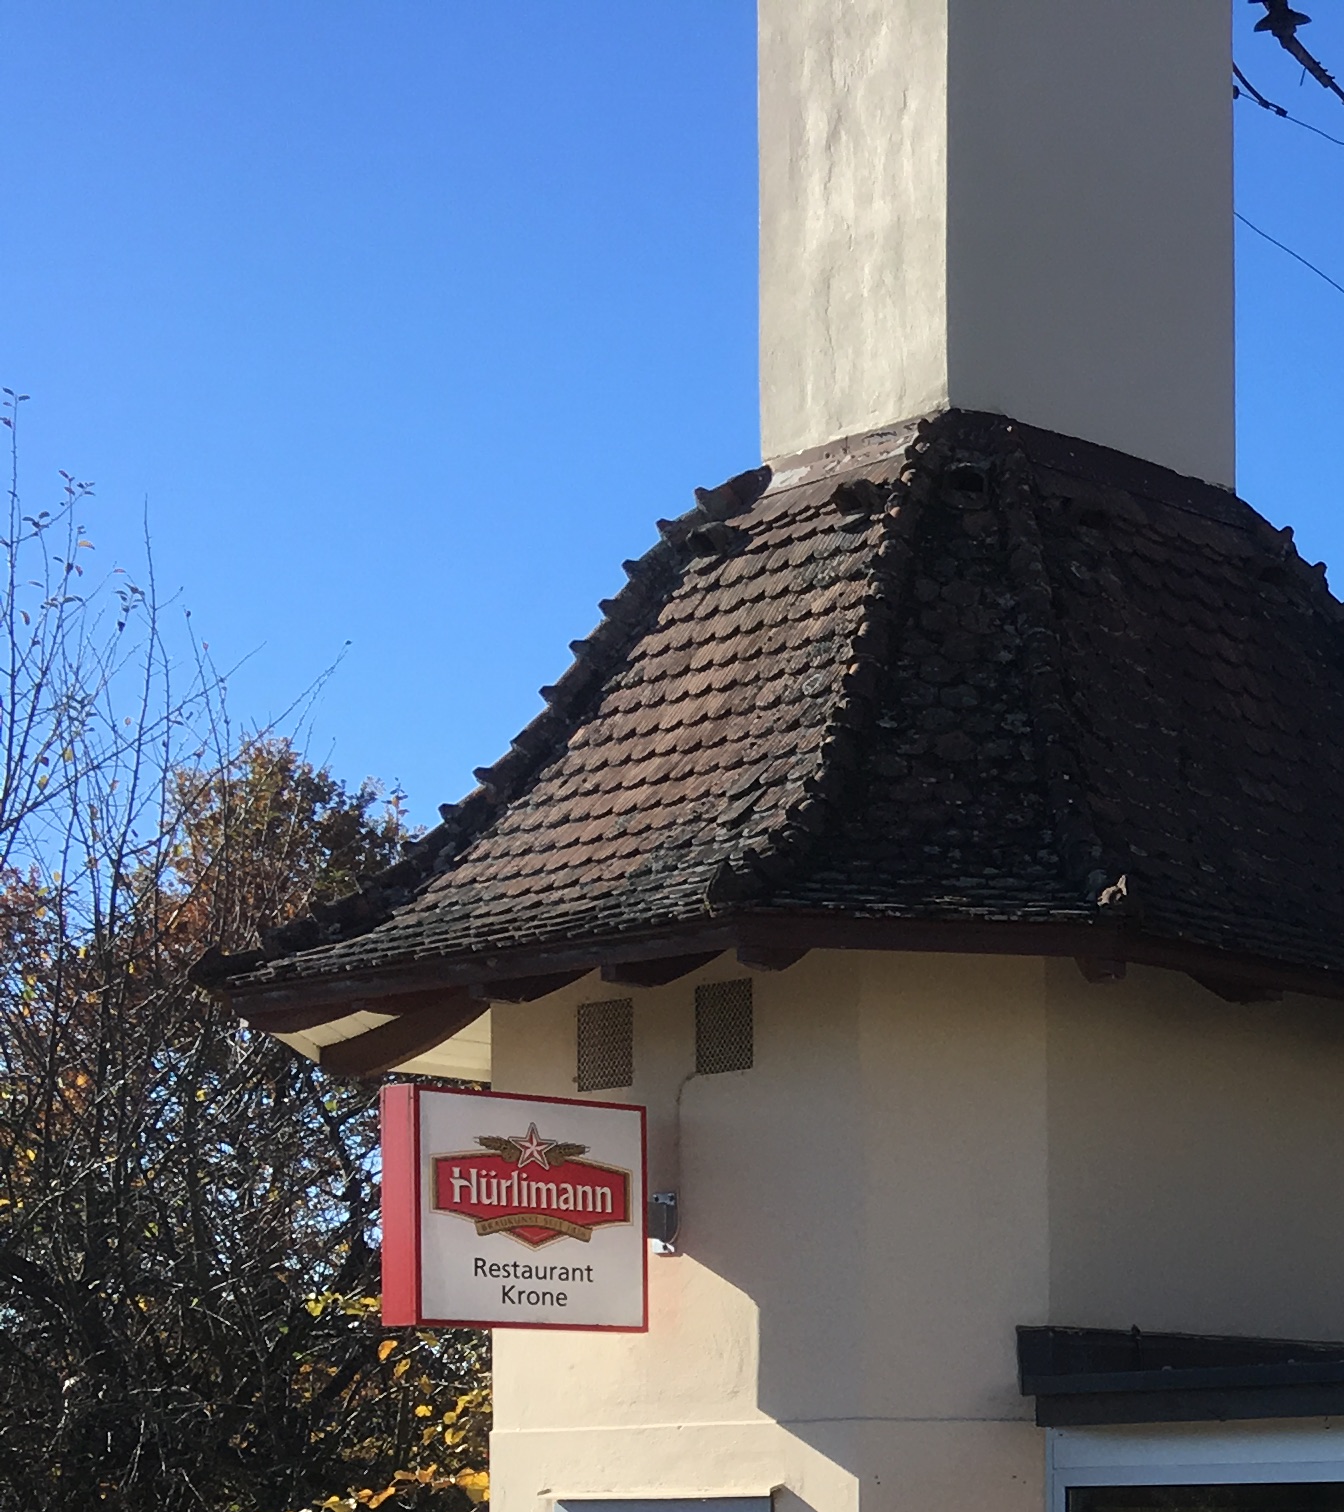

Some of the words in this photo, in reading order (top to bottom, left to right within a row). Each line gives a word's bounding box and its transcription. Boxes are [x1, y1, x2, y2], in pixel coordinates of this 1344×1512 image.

[449, 1166, 613, 1214] Hürlimann
[473, 1257, 594, 1283] Restaurant
[501, 1284, 568, 1307] Krone
